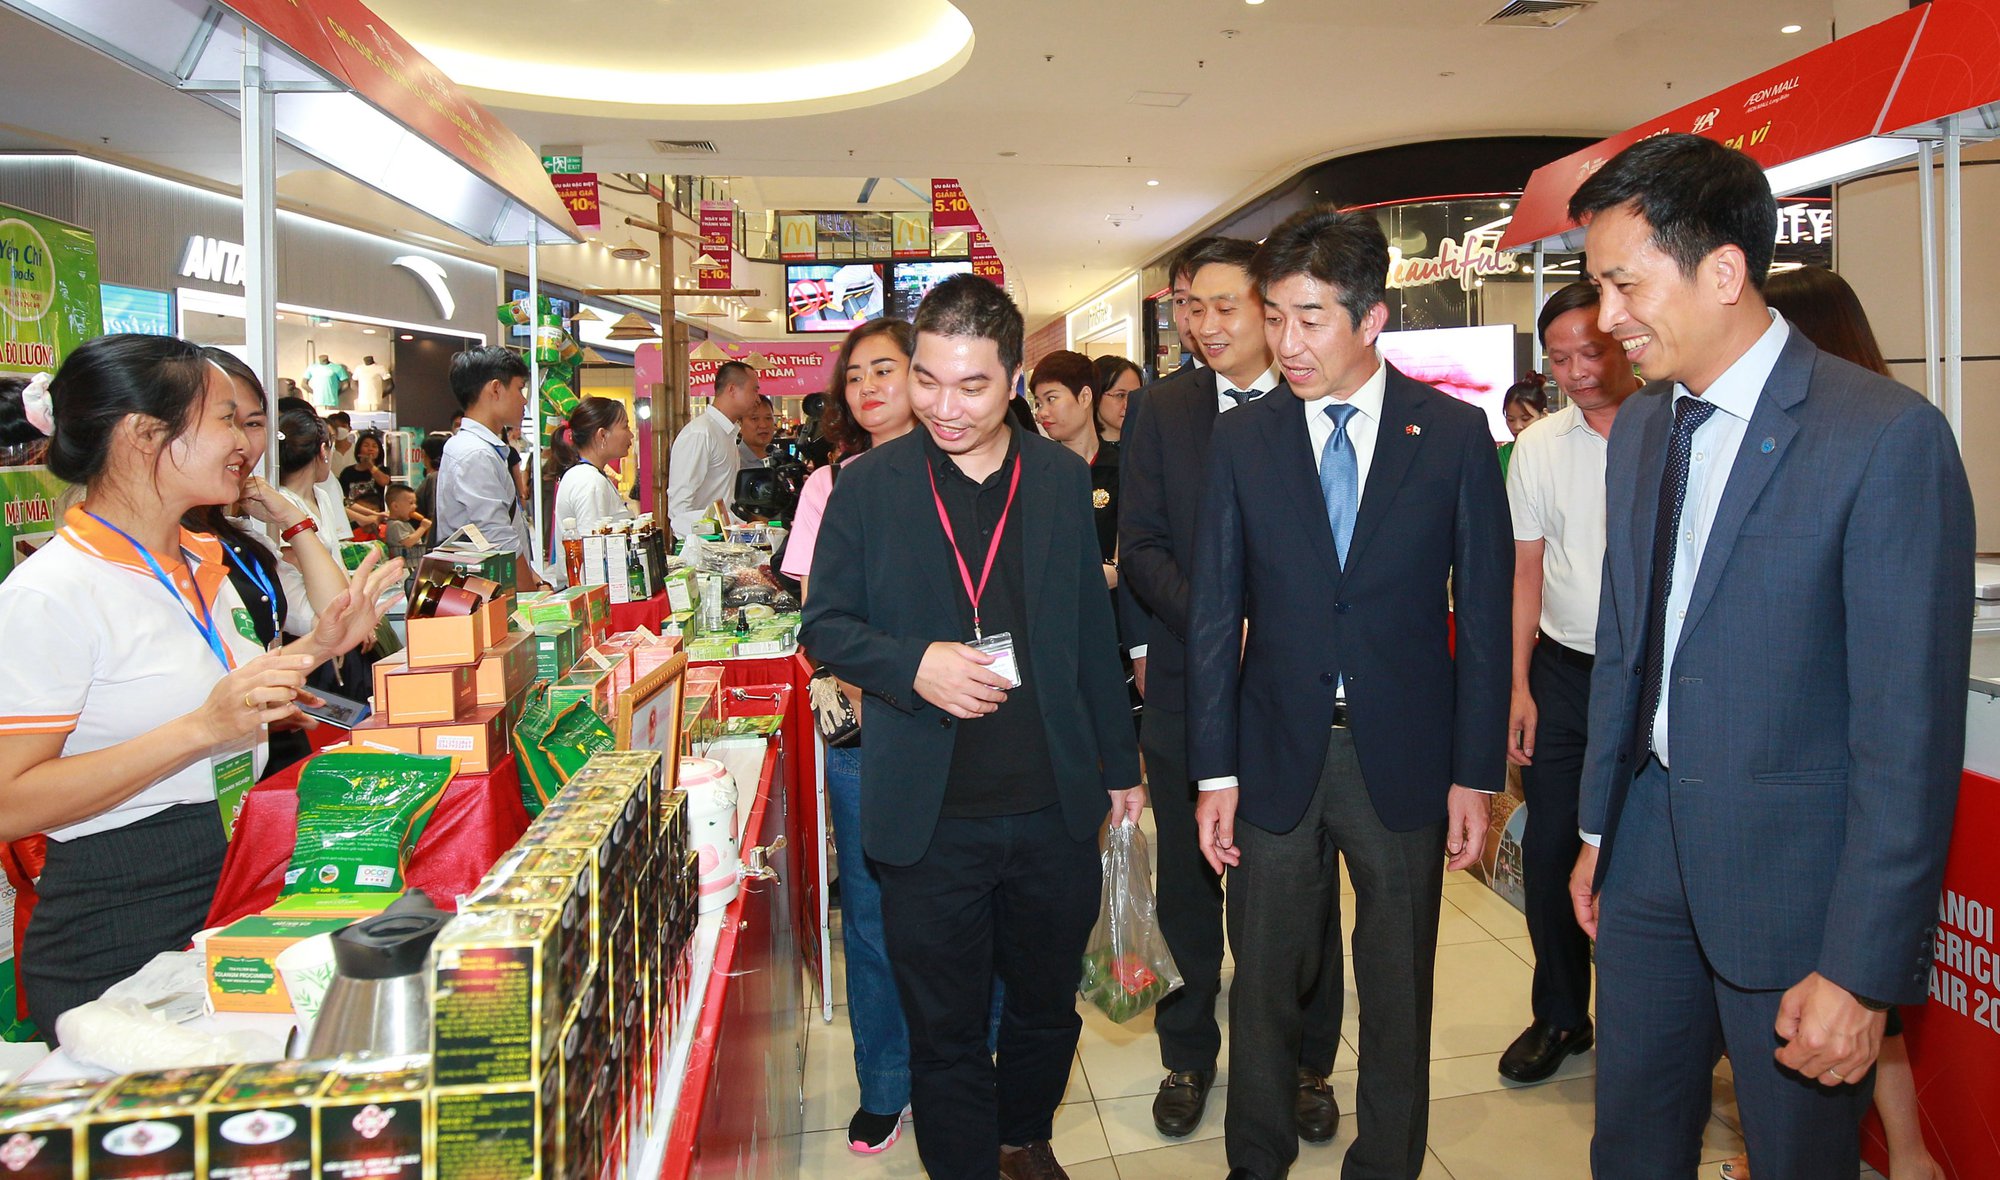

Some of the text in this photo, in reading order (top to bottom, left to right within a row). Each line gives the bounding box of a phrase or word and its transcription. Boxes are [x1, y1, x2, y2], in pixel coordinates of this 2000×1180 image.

[1770, 76, 1799, 98] MALL
[23, 245, 42, 267] Chi
[12, 265, 35, 281] oods
[790, 353, 823, 366] THIẾT
[765, 369, 795, 377] NAM
[25, 493, 49, 521] MÍA
[364, 868, 389, 876] OCOP
[1, 887, 17, 898] OCO
[1938, 888, 1994, 944] NOI
[1928, 965, 1968, 1017] AIR
